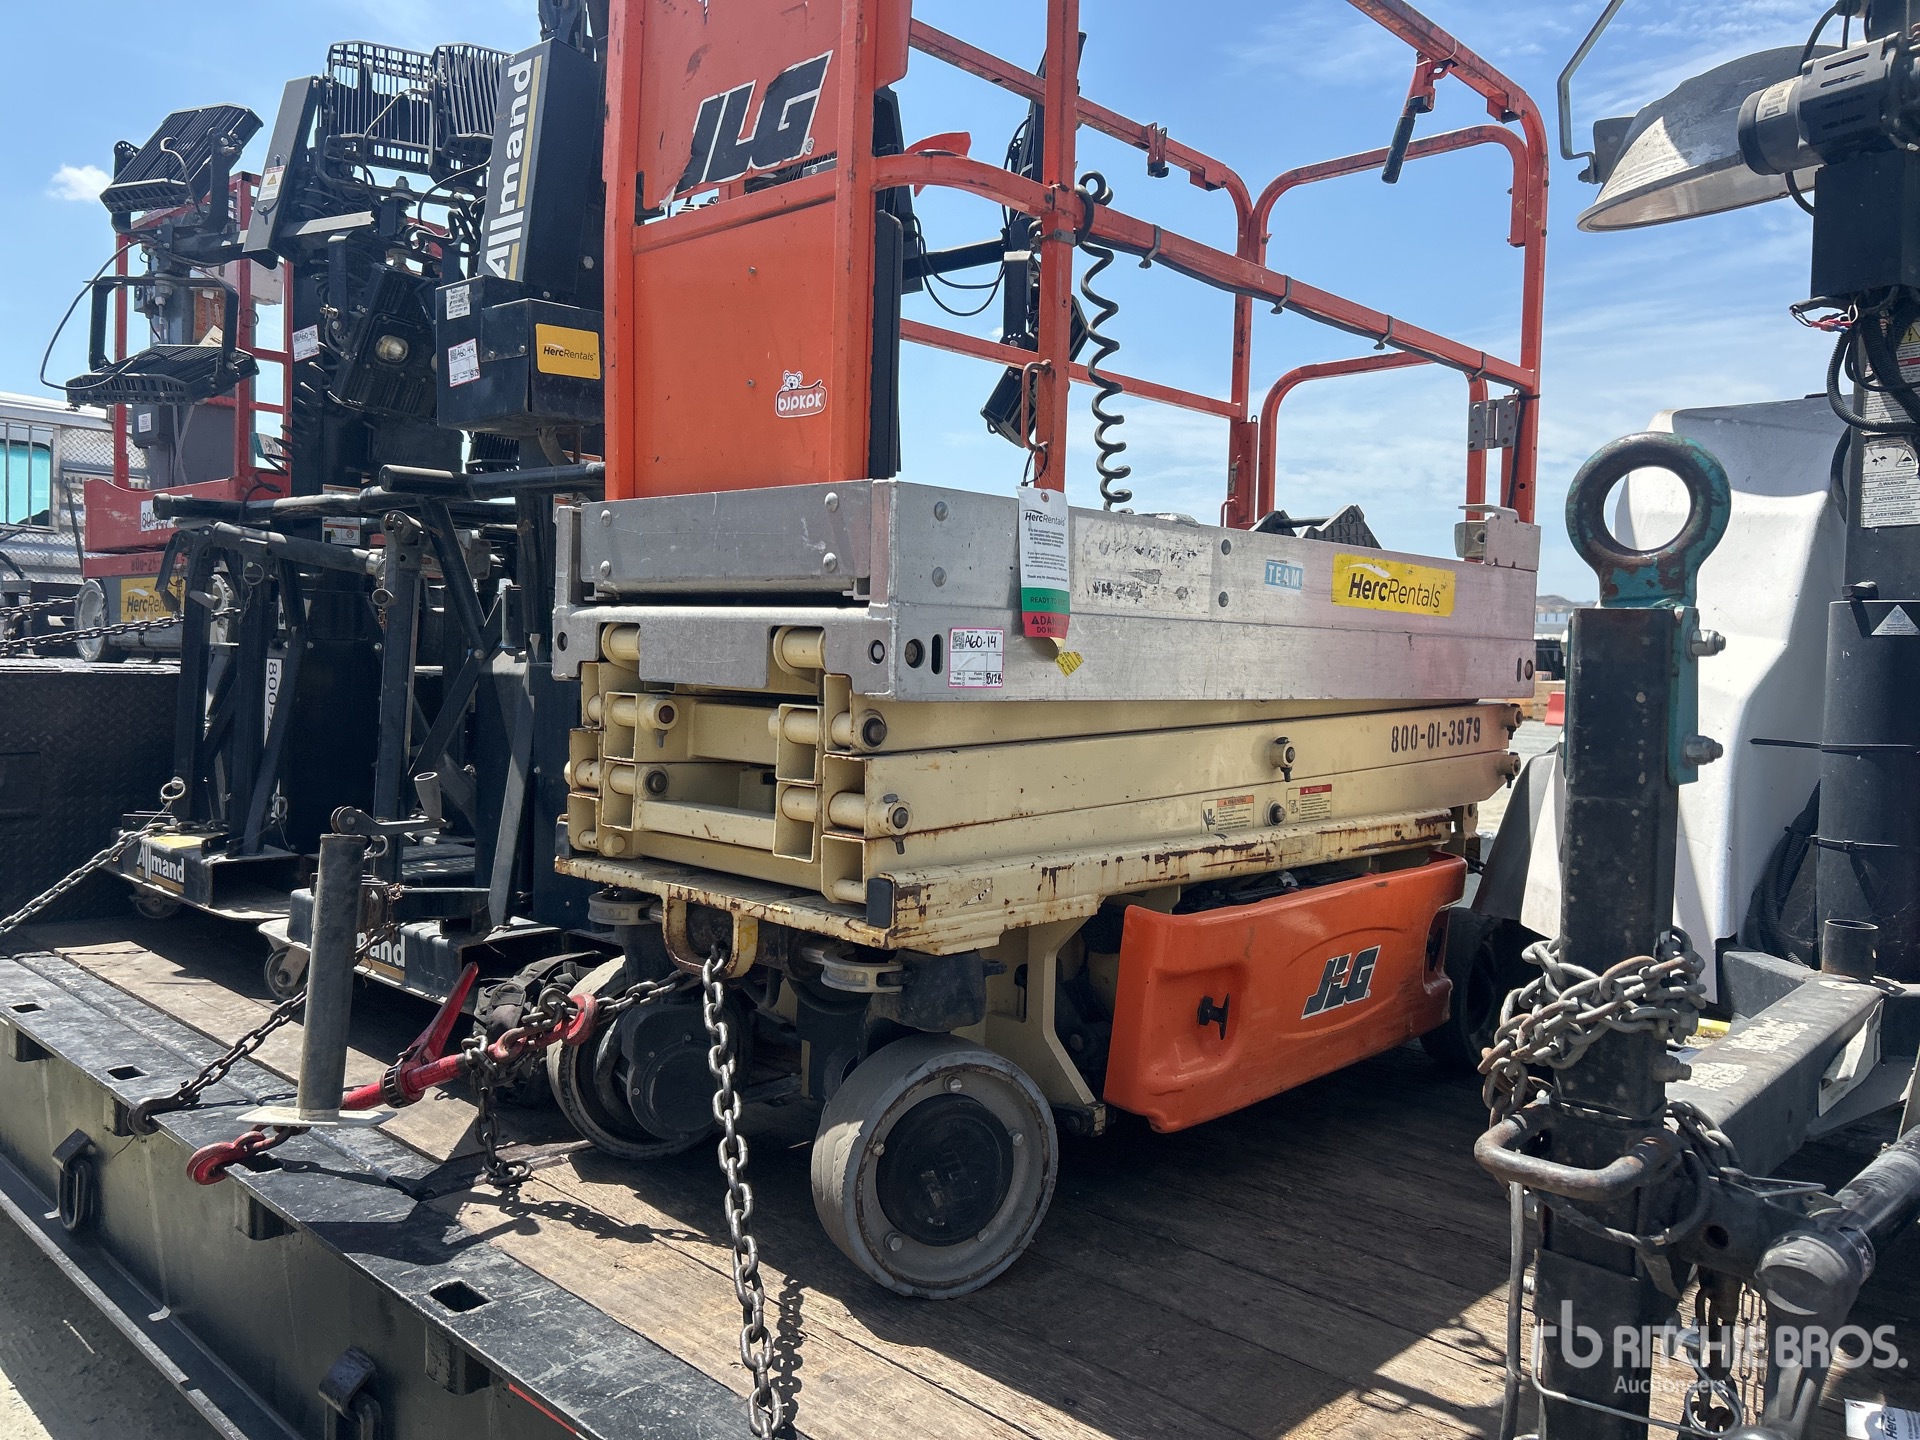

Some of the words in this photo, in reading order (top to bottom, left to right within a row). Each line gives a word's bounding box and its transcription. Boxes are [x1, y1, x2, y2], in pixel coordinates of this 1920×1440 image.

[668, 50, 834, 202] JLG
[486, 58, 532, 279] Allmand
[543, 346, 594, 361] HercRentals
[1025, 512, 1065, 527] HercRentals
[1269, 564, 1300, 588] TEAM
[1348, 572, 1441, 608] HercRentals
[1030, 596, 1049, 604] READY
[1391, 716, 1481, 753] 800-01-3979
[136, 843, 185, 883] Allmand
[1300, 944, 1382, 1020] JLG
